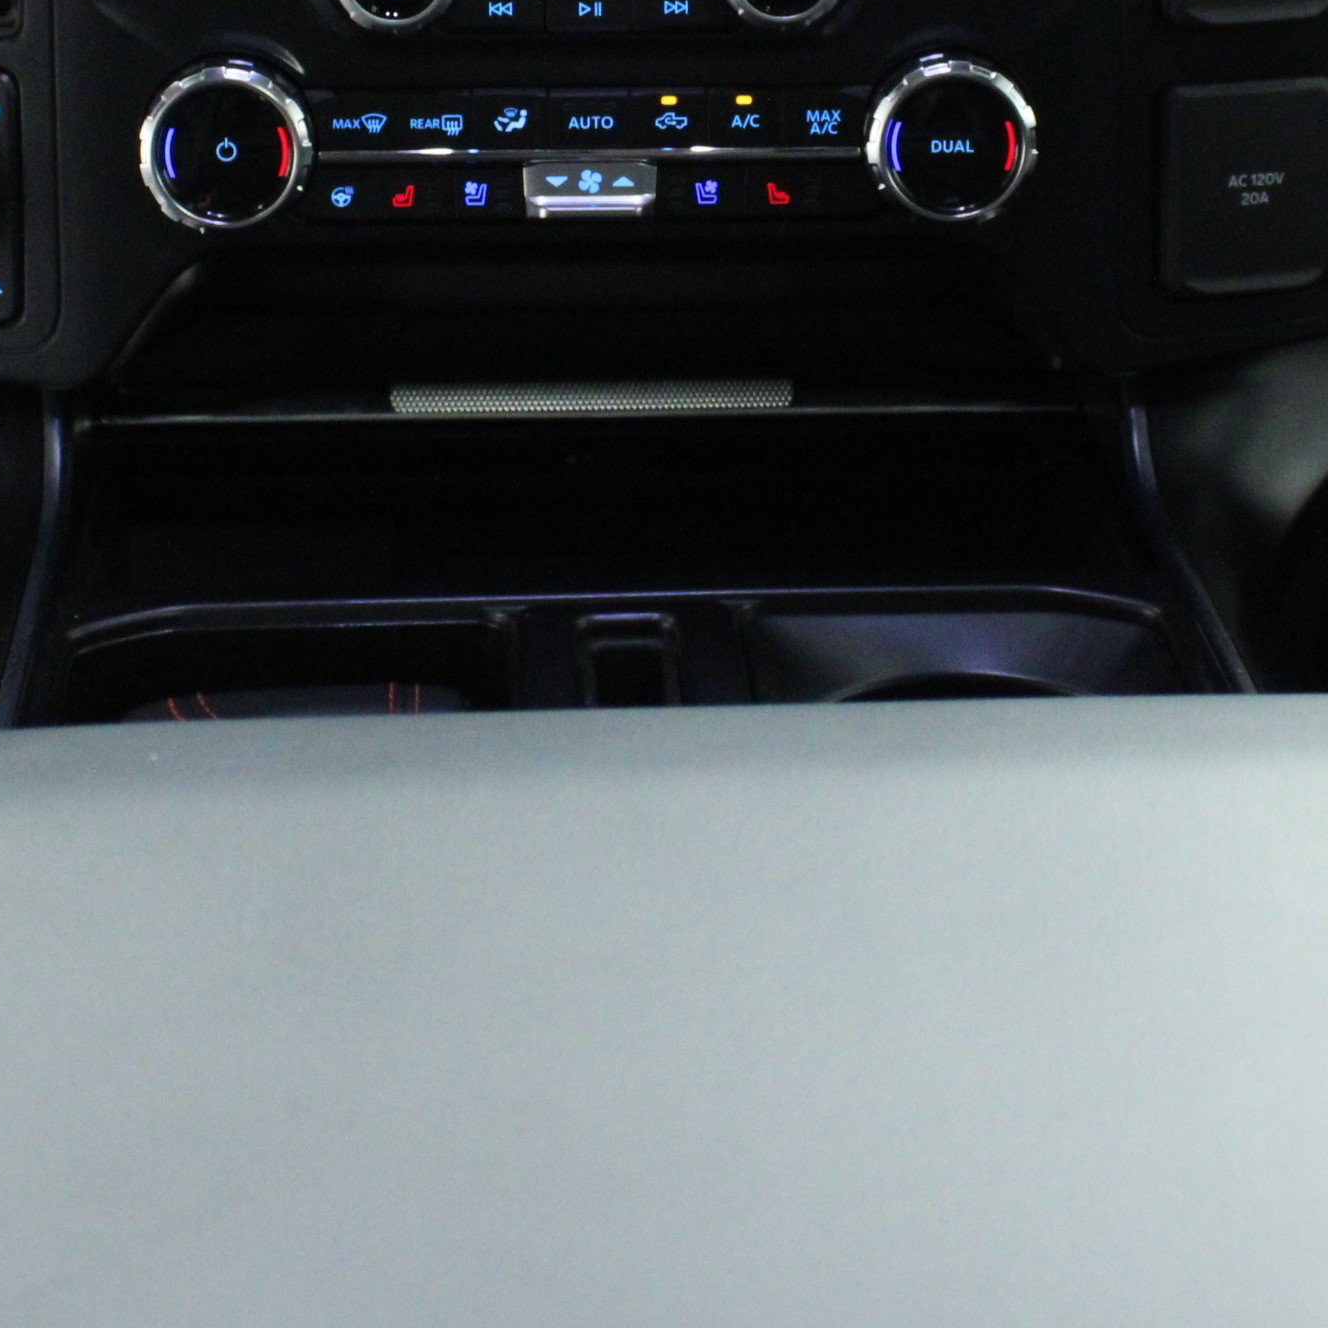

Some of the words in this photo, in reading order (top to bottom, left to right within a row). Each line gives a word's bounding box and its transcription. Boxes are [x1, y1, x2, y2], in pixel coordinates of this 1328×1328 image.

[332, 117, 363, 131] MAX
[409, 117, 440, 130] REAR
[568, 115, 615, 131] AUTO
[731, 114, 761, 129] A/C
[806, 110, 842, 123] MAX
[810, 122, 839, 135] A/C
[930, 139, 975, 154] DUAL
[1228, 174, 1249, 189] AC
[1251, 173, 1285, 187] 120V
[1241, 191, 1269, 206] 20A
